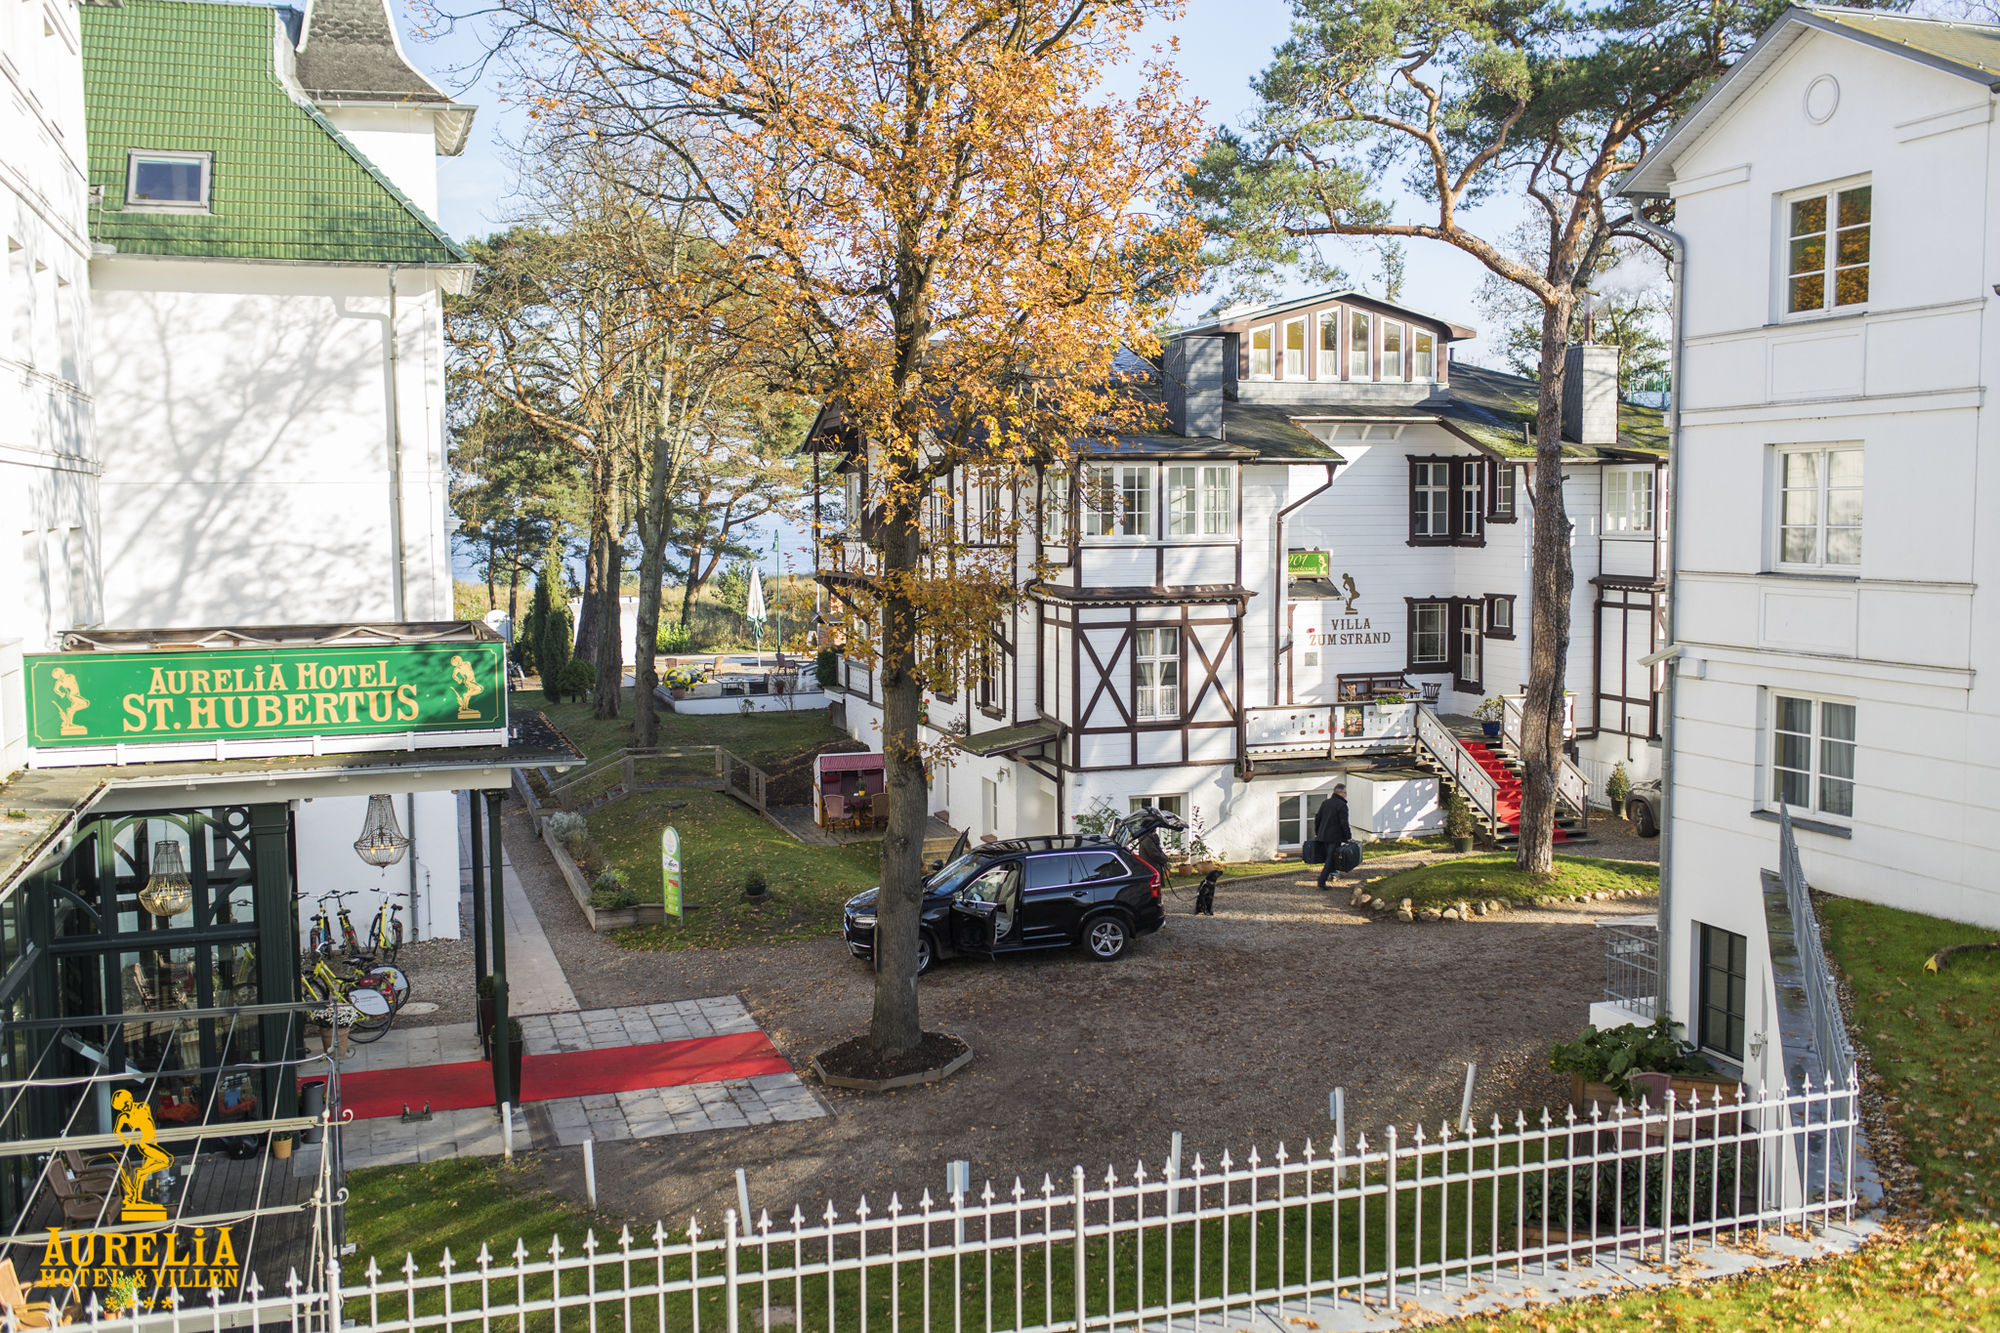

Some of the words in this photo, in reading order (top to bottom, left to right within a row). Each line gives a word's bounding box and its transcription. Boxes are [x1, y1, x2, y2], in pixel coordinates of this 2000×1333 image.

[1331, 617, 1371, 630] VILLA
[1309, 633, 1337, 646] ZUM
[1340, 632, 1391, 645] STRAND
[296, 660, 397, 690] HOTEL
